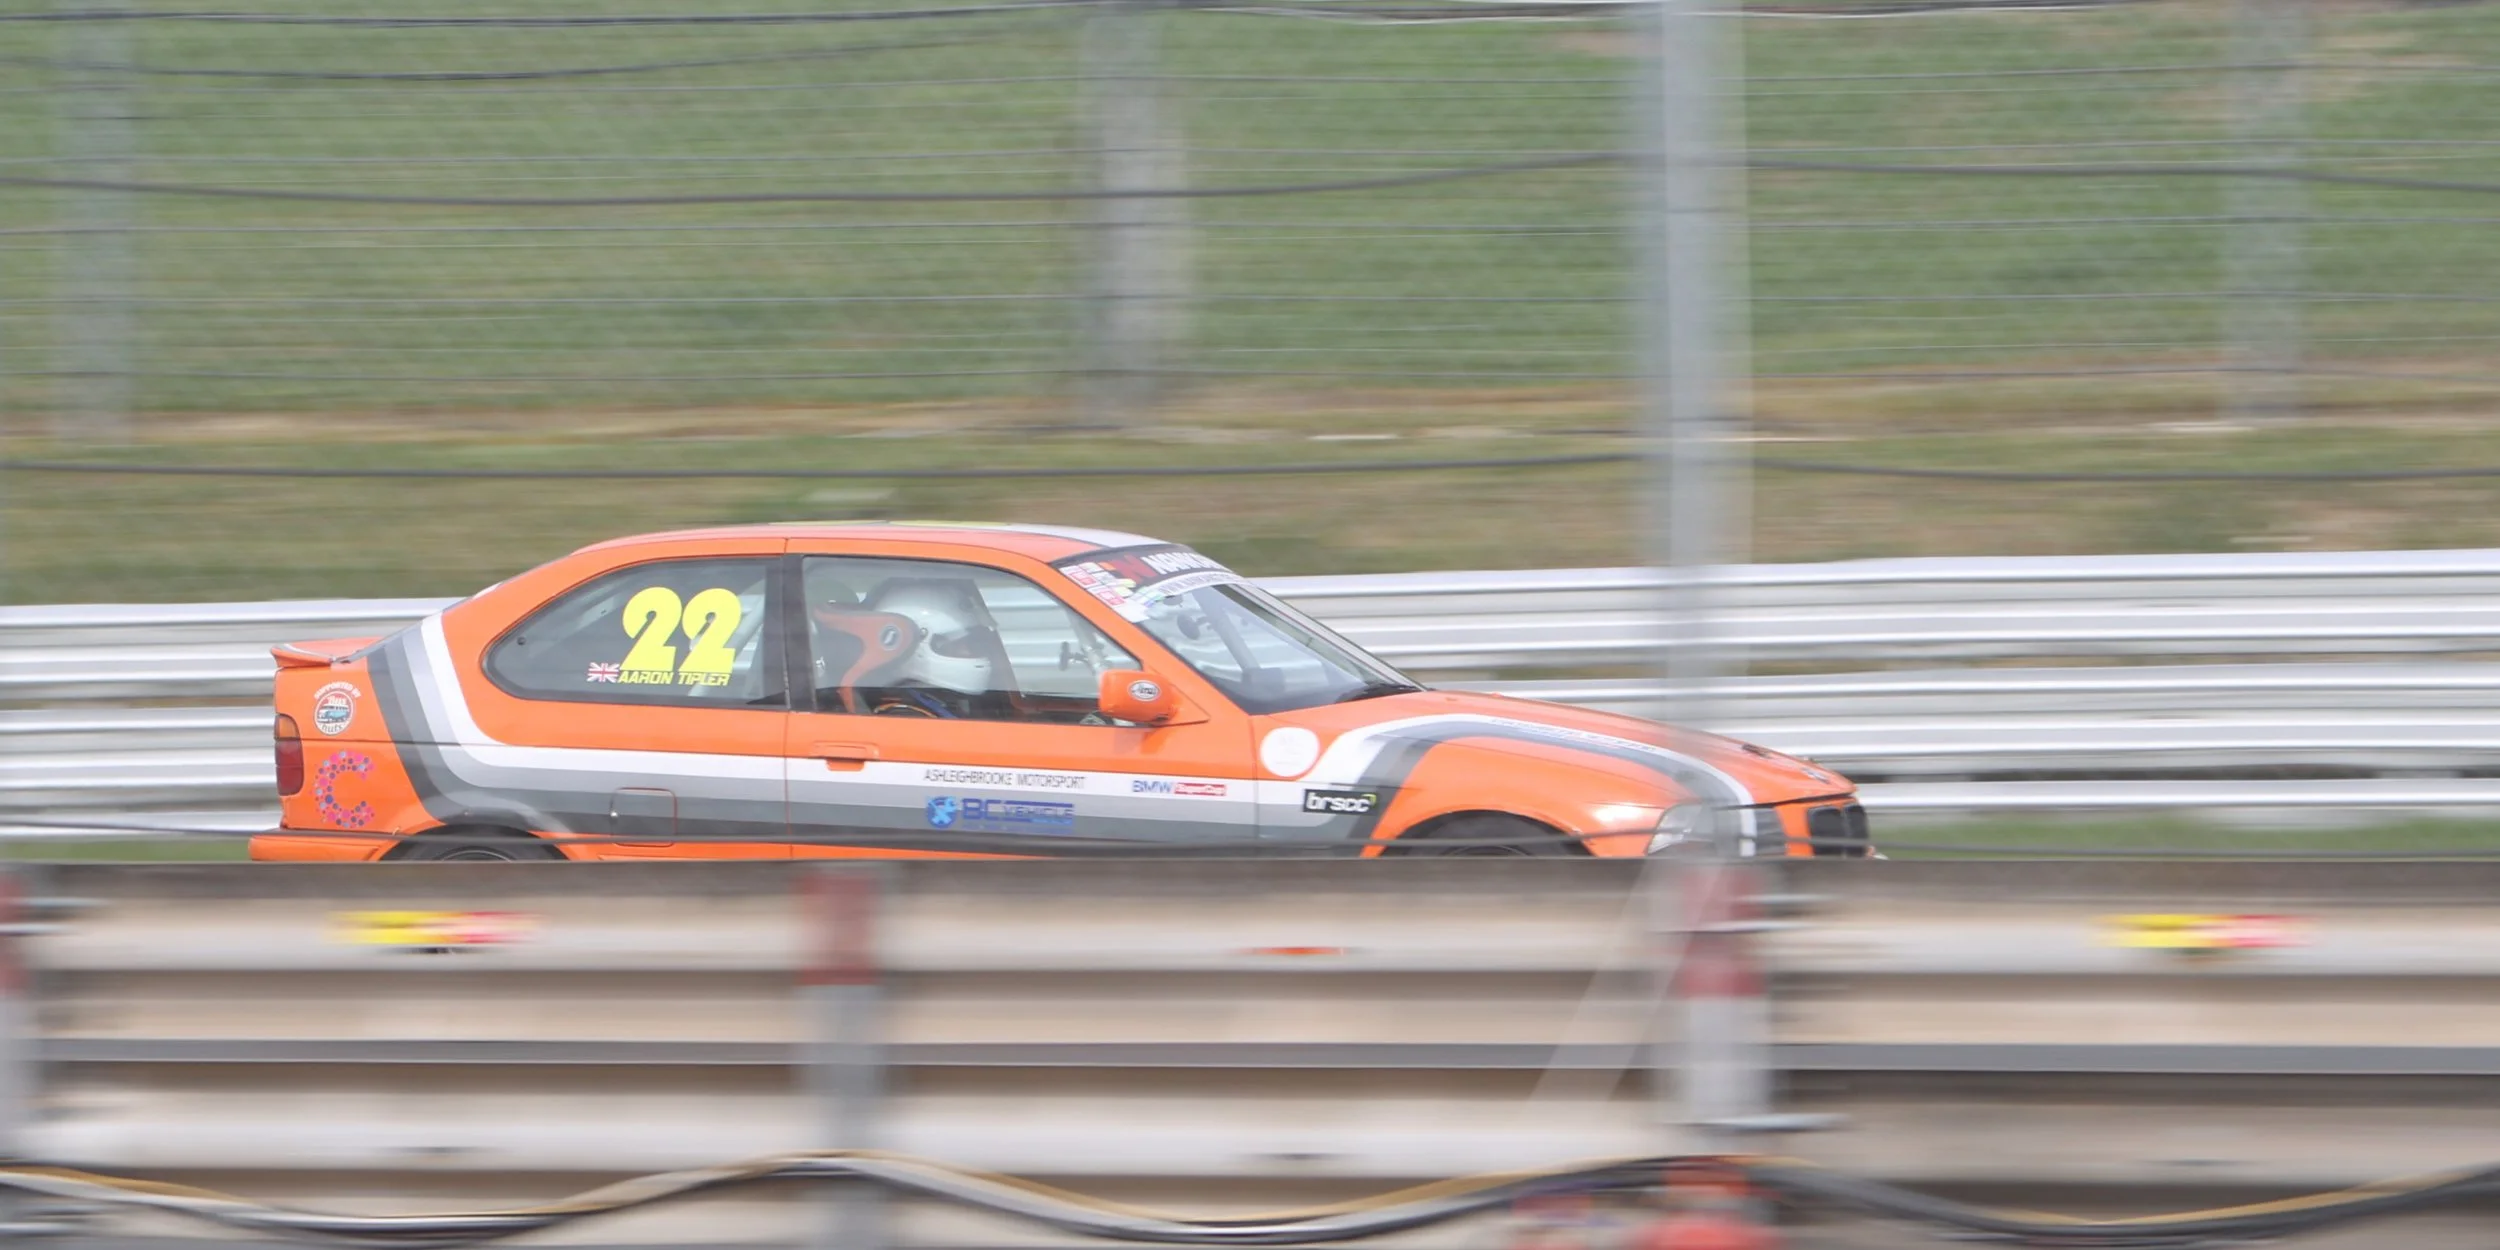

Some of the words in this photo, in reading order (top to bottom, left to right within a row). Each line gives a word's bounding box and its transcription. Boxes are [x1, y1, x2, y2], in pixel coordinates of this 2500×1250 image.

[620, 587, 741, 672] 22
[618, 672, 673, 684] AARON
[678, 673, 730, 686] TIPLER
[1017, 774, 1086, 789] MOTORSPORT
[1133, 780, 1172, 793] BMW
[1306, 792, 1371, 812] brscc
